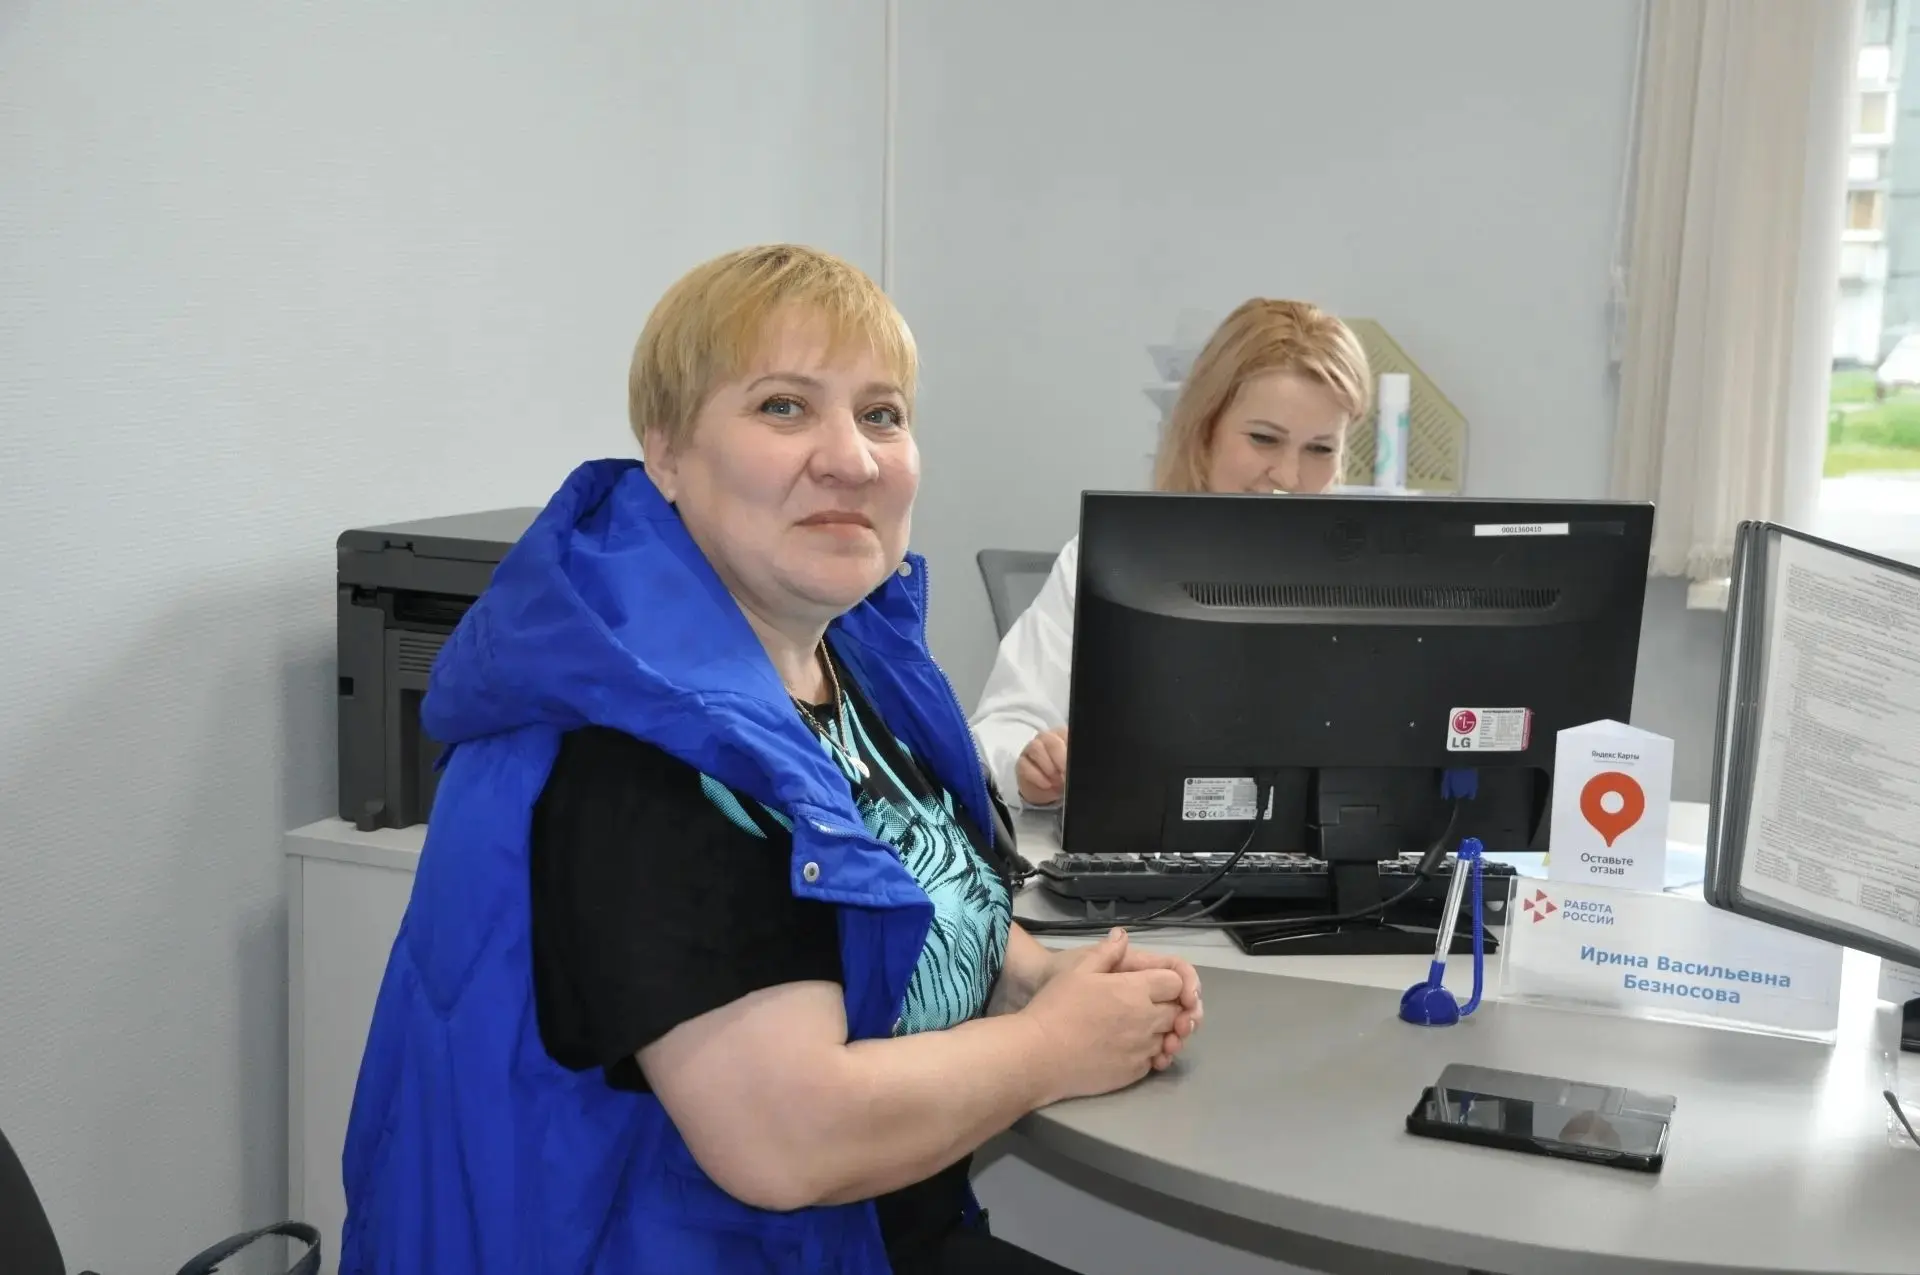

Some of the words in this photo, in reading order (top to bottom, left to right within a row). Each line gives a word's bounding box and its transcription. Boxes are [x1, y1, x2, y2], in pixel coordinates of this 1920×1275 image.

[1451, 737, 1471, 748] LG
[1591, 750, 1616, 759] Яндекс
[1617, 752, 1640, 760] Карты
[1580, 852, 1634, 866] Оставьте
[1590, 866, 1625, 876] отзыв
[1563, 900, 1613, 914] РАБОТА
[1562, 911, 1615, 926] РОССИИ
[1580, 945, 1649, 968] Ирина
[1656, 955, 1792, 988] Васильевна
[1623, 973, 1741, 1004] Безносова
